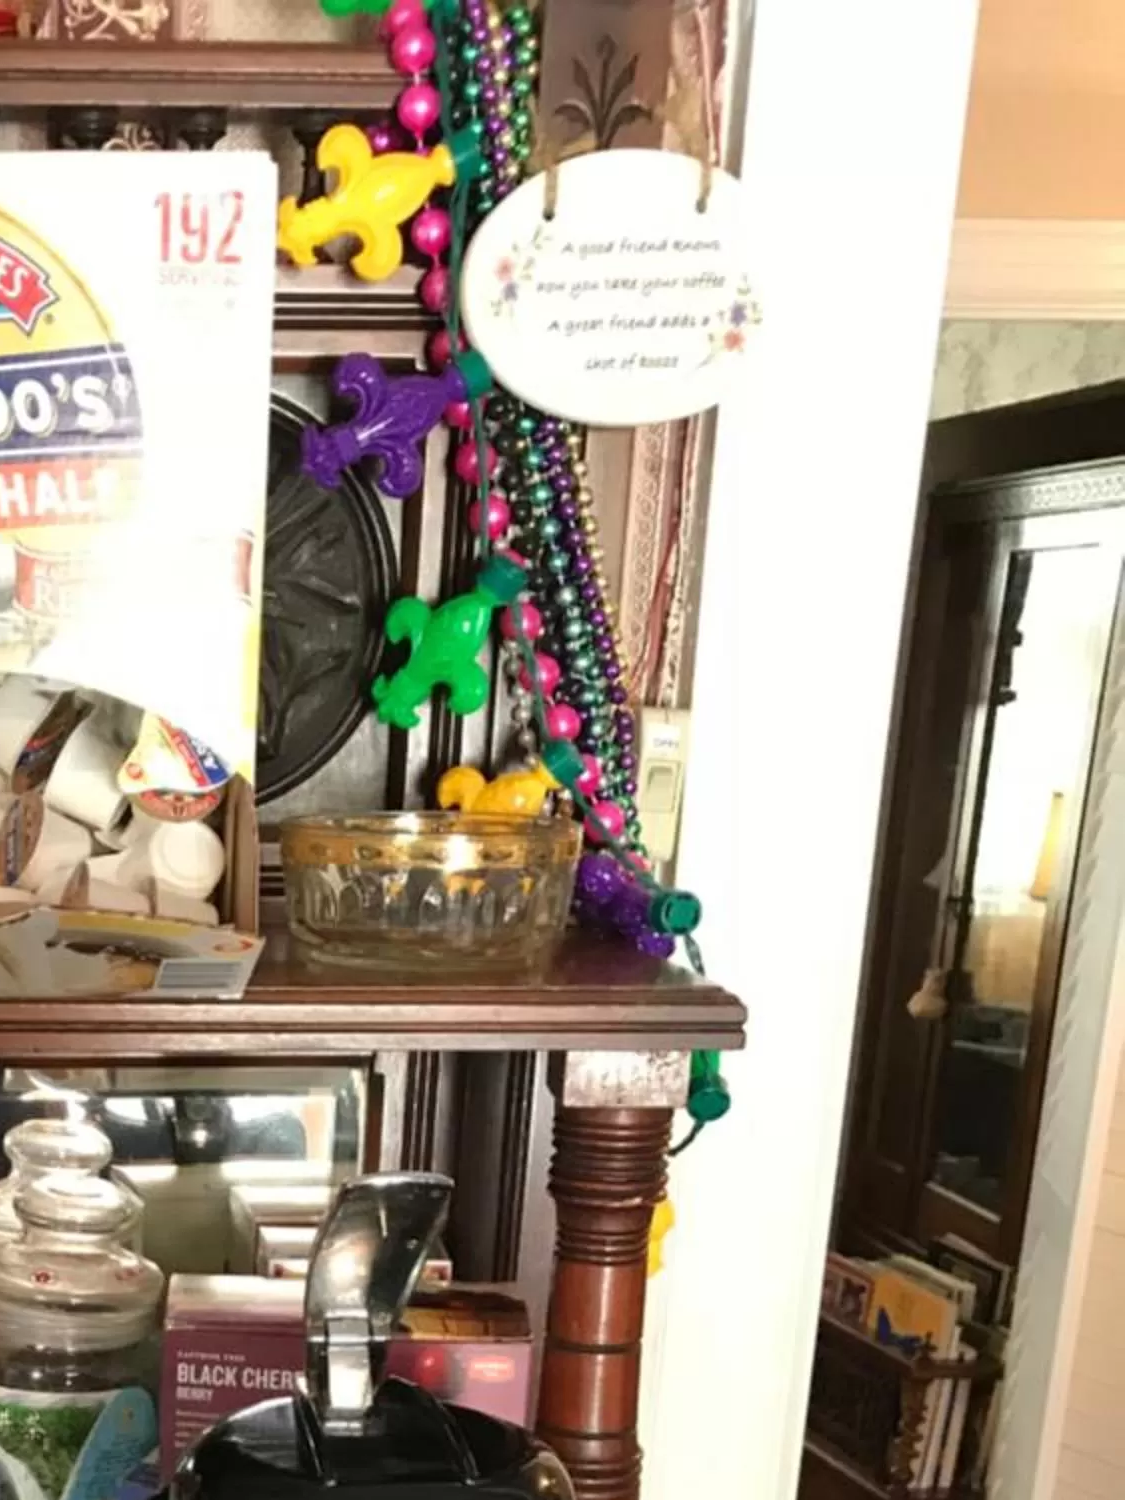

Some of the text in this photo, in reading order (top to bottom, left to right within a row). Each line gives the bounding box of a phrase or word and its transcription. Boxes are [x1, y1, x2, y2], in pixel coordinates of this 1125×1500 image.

[619, 236, 669, 255] friend
[609, 313, 657, 332] friend
[176, 1361, 305, 1391] BLACK CHER
